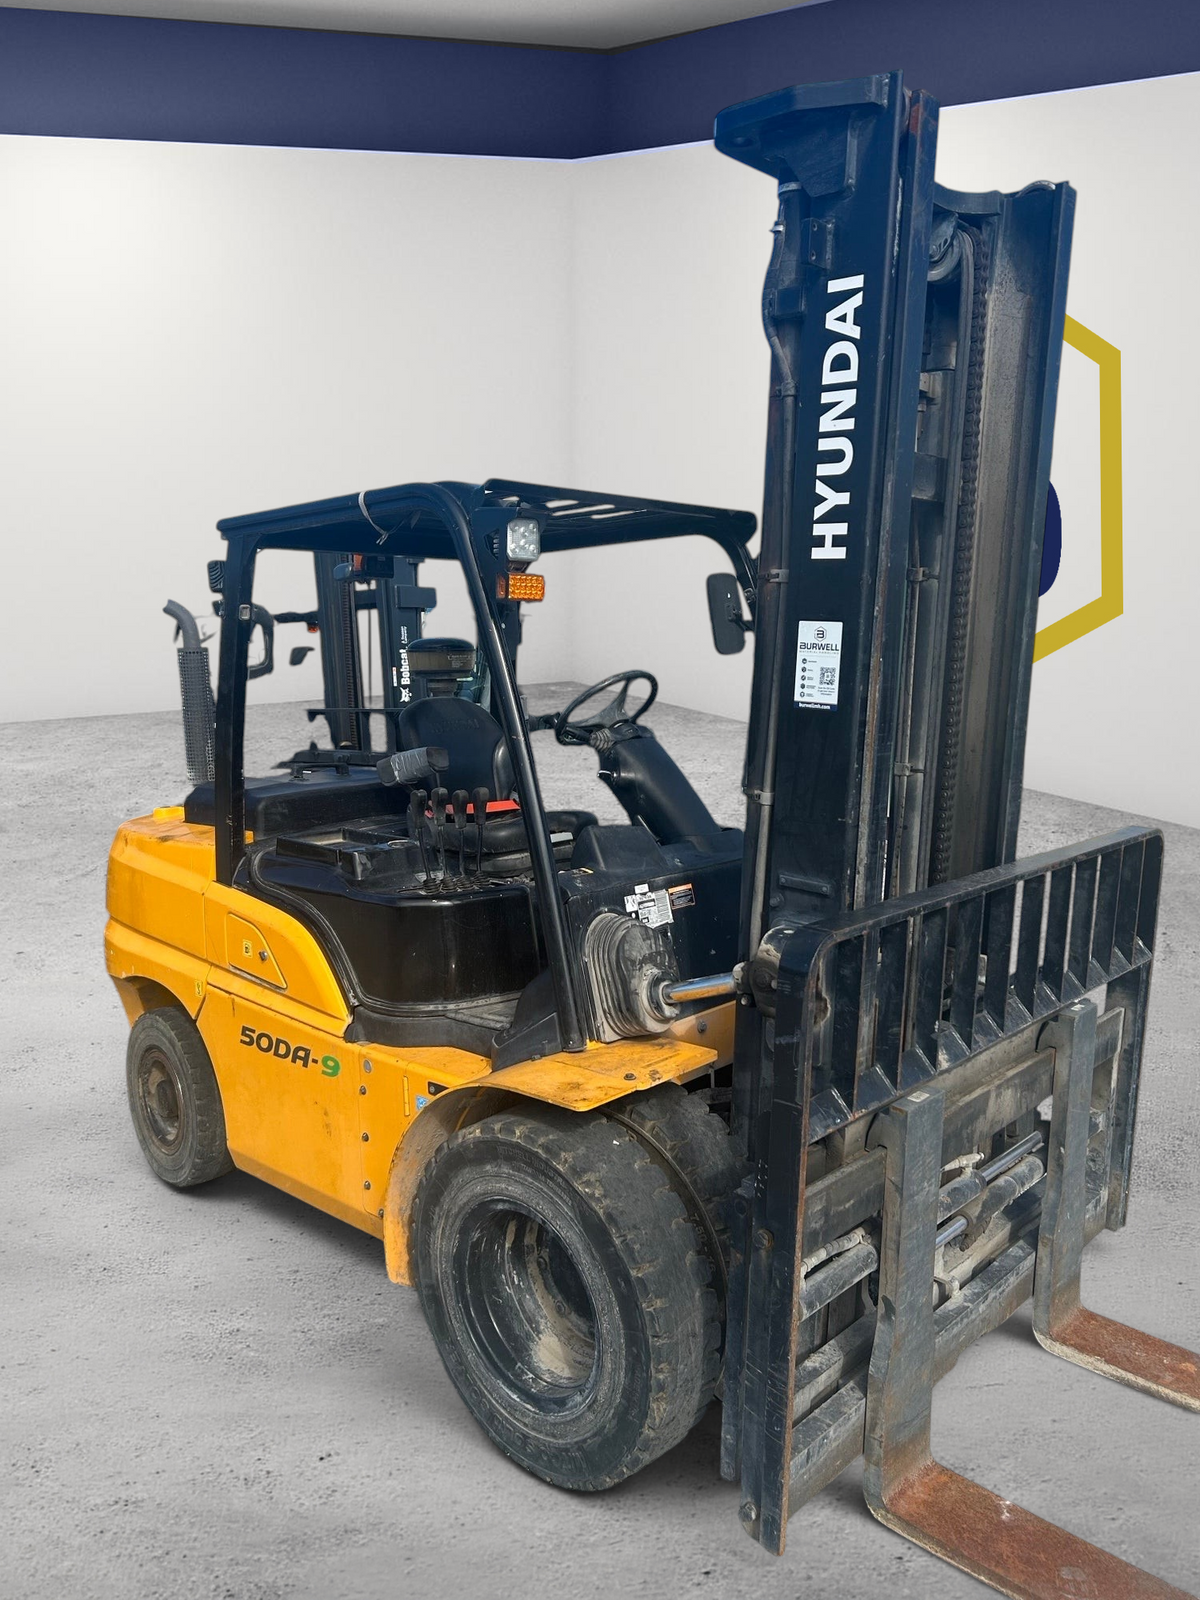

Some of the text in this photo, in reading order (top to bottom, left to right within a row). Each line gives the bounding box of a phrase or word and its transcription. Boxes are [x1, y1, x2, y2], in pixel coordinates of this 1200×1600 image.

[811, 274, 865, 560] HYUNDAI
[799, 642, 839, 651] BURWELL
[399, 649, 411, 685] Bobcat
